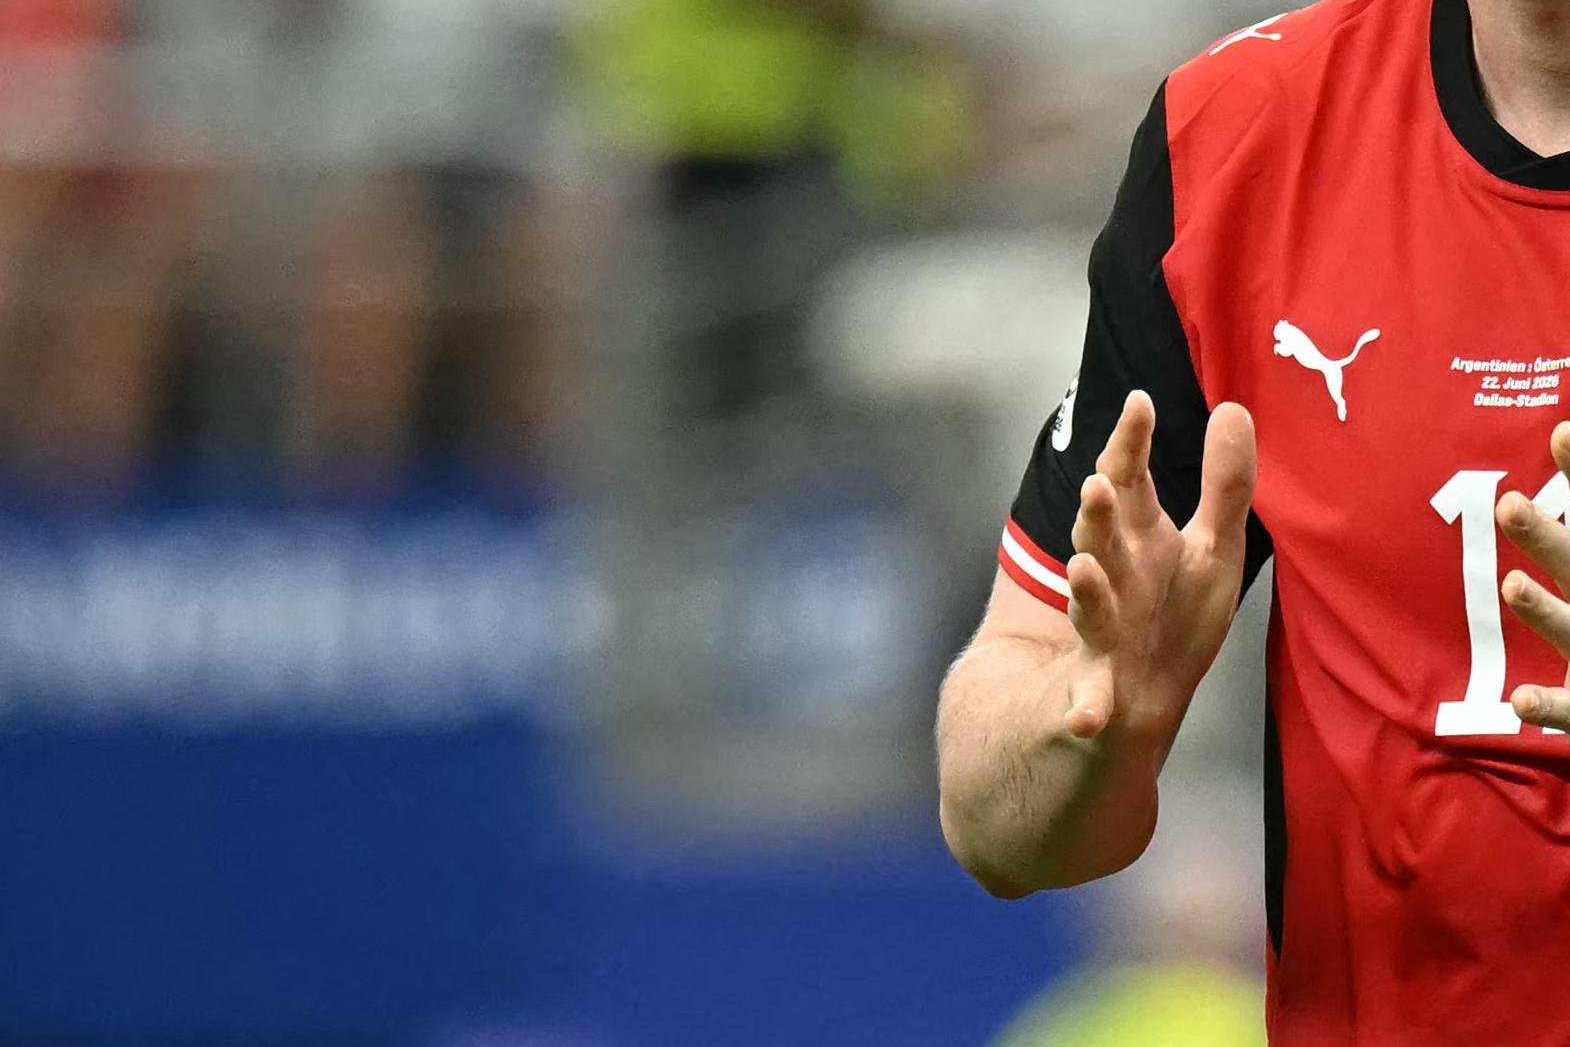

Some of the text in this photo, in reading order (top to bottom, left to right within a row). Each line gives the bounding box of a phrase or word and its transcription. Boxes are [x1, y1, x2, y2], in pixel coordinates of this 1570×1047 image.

[1451, 357, 1526, 373] Argentinien
[1481, 375, 1559, 390] 22. Juni 2026
[1473, 393, 1559, 407] Dallas-Stadion
